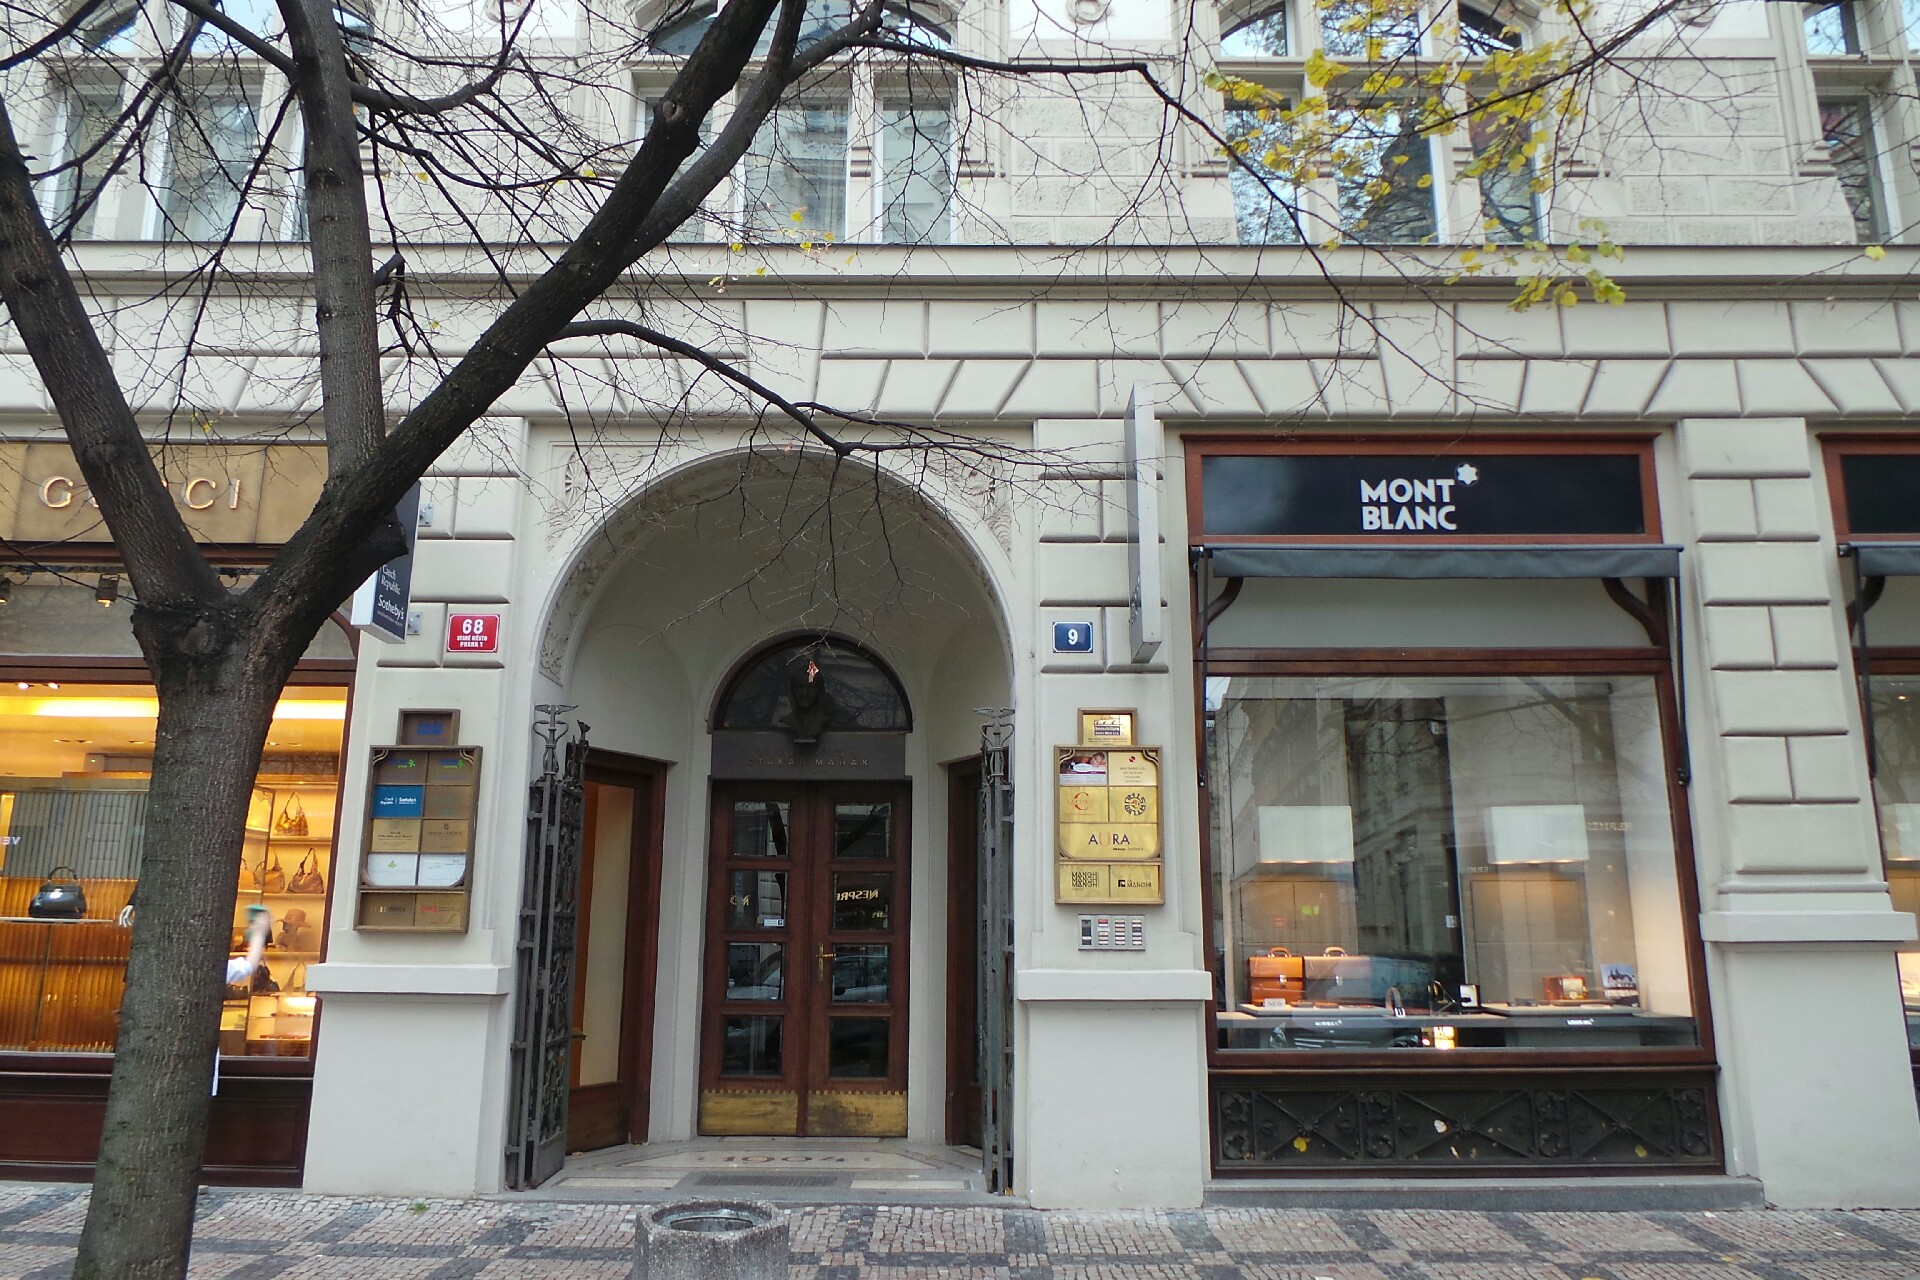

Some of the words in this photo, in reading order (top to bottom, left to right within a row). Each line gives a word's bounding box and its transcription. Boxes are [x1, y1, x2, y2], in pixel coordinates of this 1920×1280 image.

[38, 476, 241, 509] GCI
[1360, 478, 1456, 503] MONT
[1362, 505, 1458, 530] BLANC
[382, 564, 397, 580] Czech
[381, 574, 401, 595] Republic
[377, 594, 405, 621] Sotheby's
[462, 618, 484, 635] 68
[1067, 628, 1079, 645] 9
[1087, 831, 1131, 847] AURA
